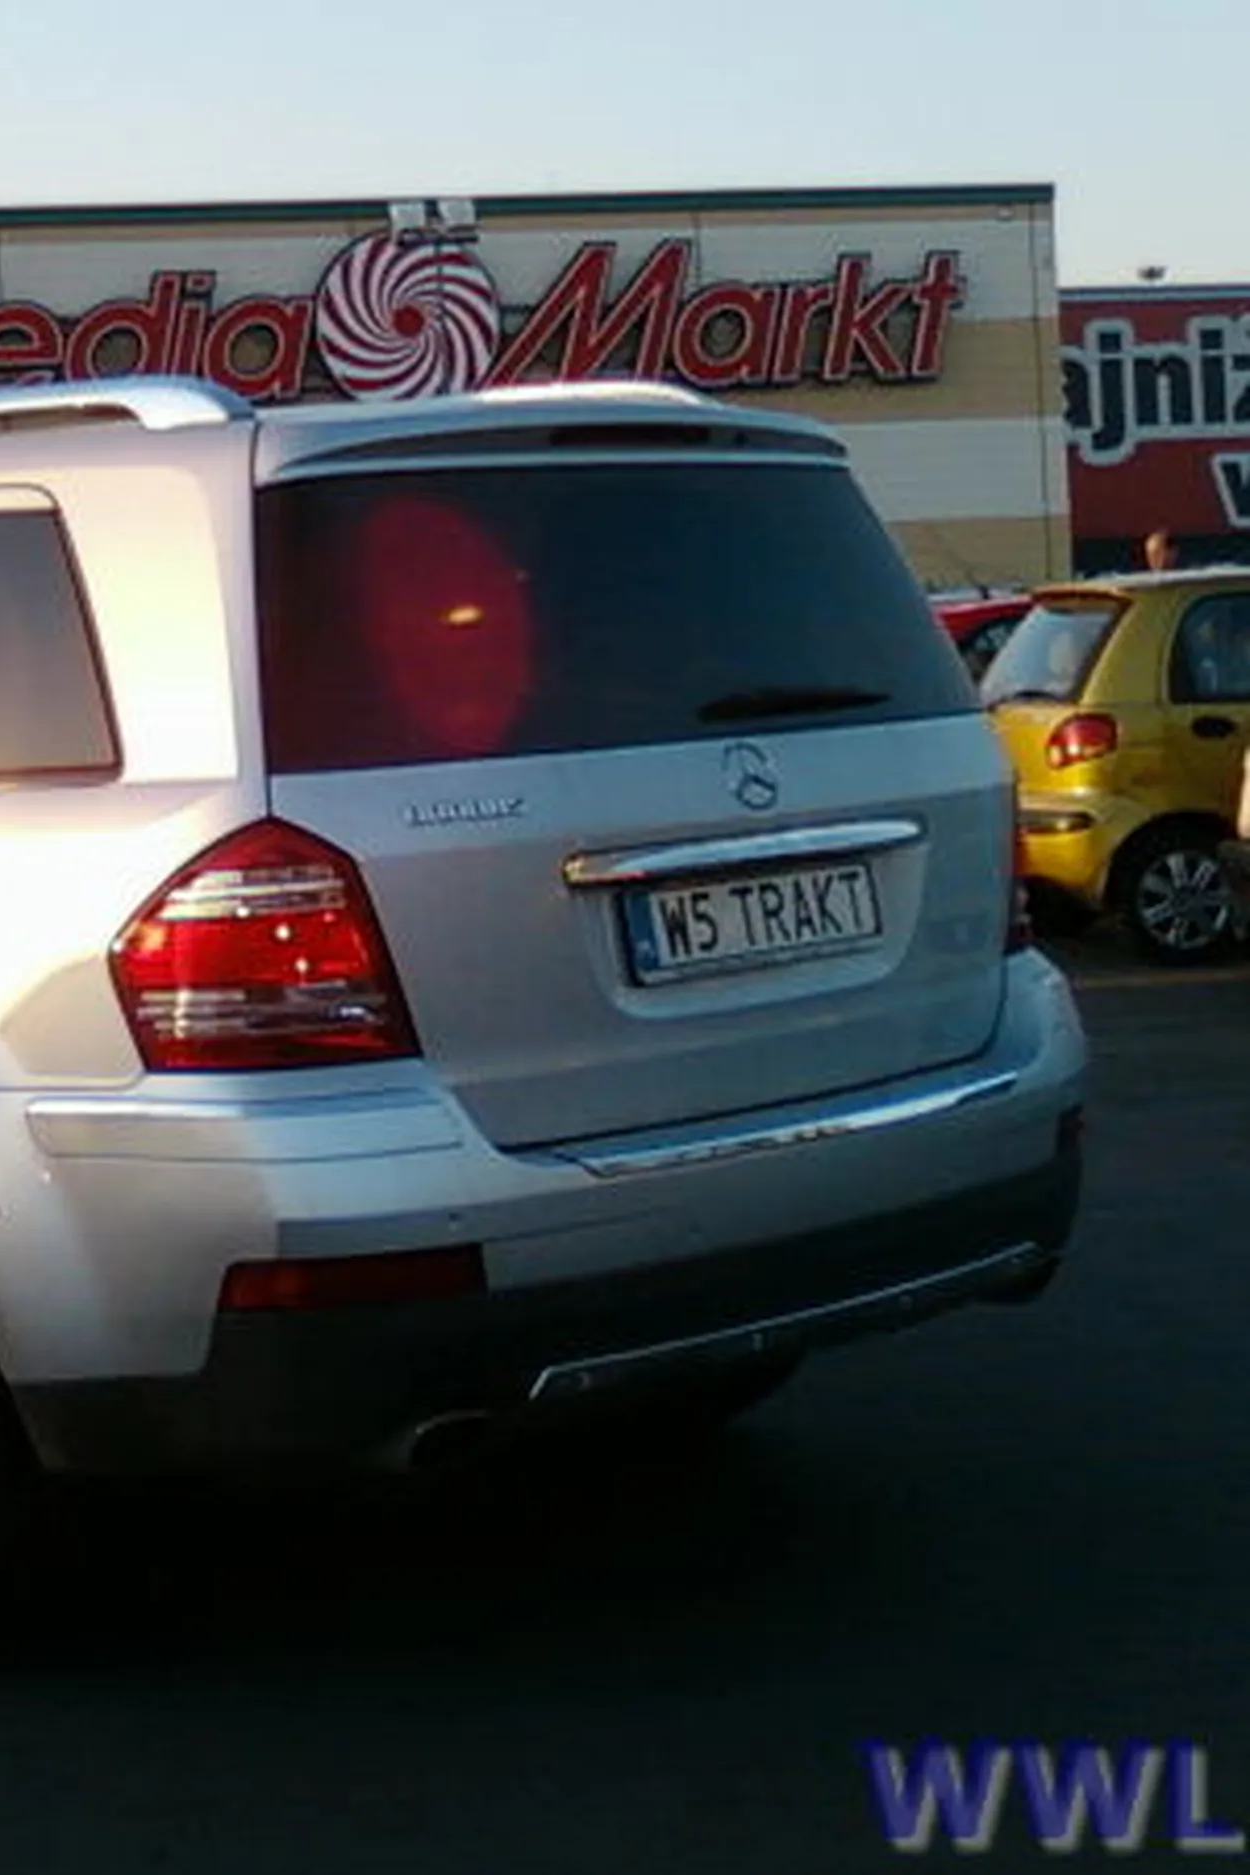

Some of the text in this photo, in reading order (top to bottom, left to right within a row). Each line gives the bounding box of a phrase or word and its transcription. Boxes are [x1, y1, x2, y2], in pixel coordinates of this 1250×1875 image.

[478, 239, 965, 386] Markt
[658, 871, 862, 958] W5 TRAKT
